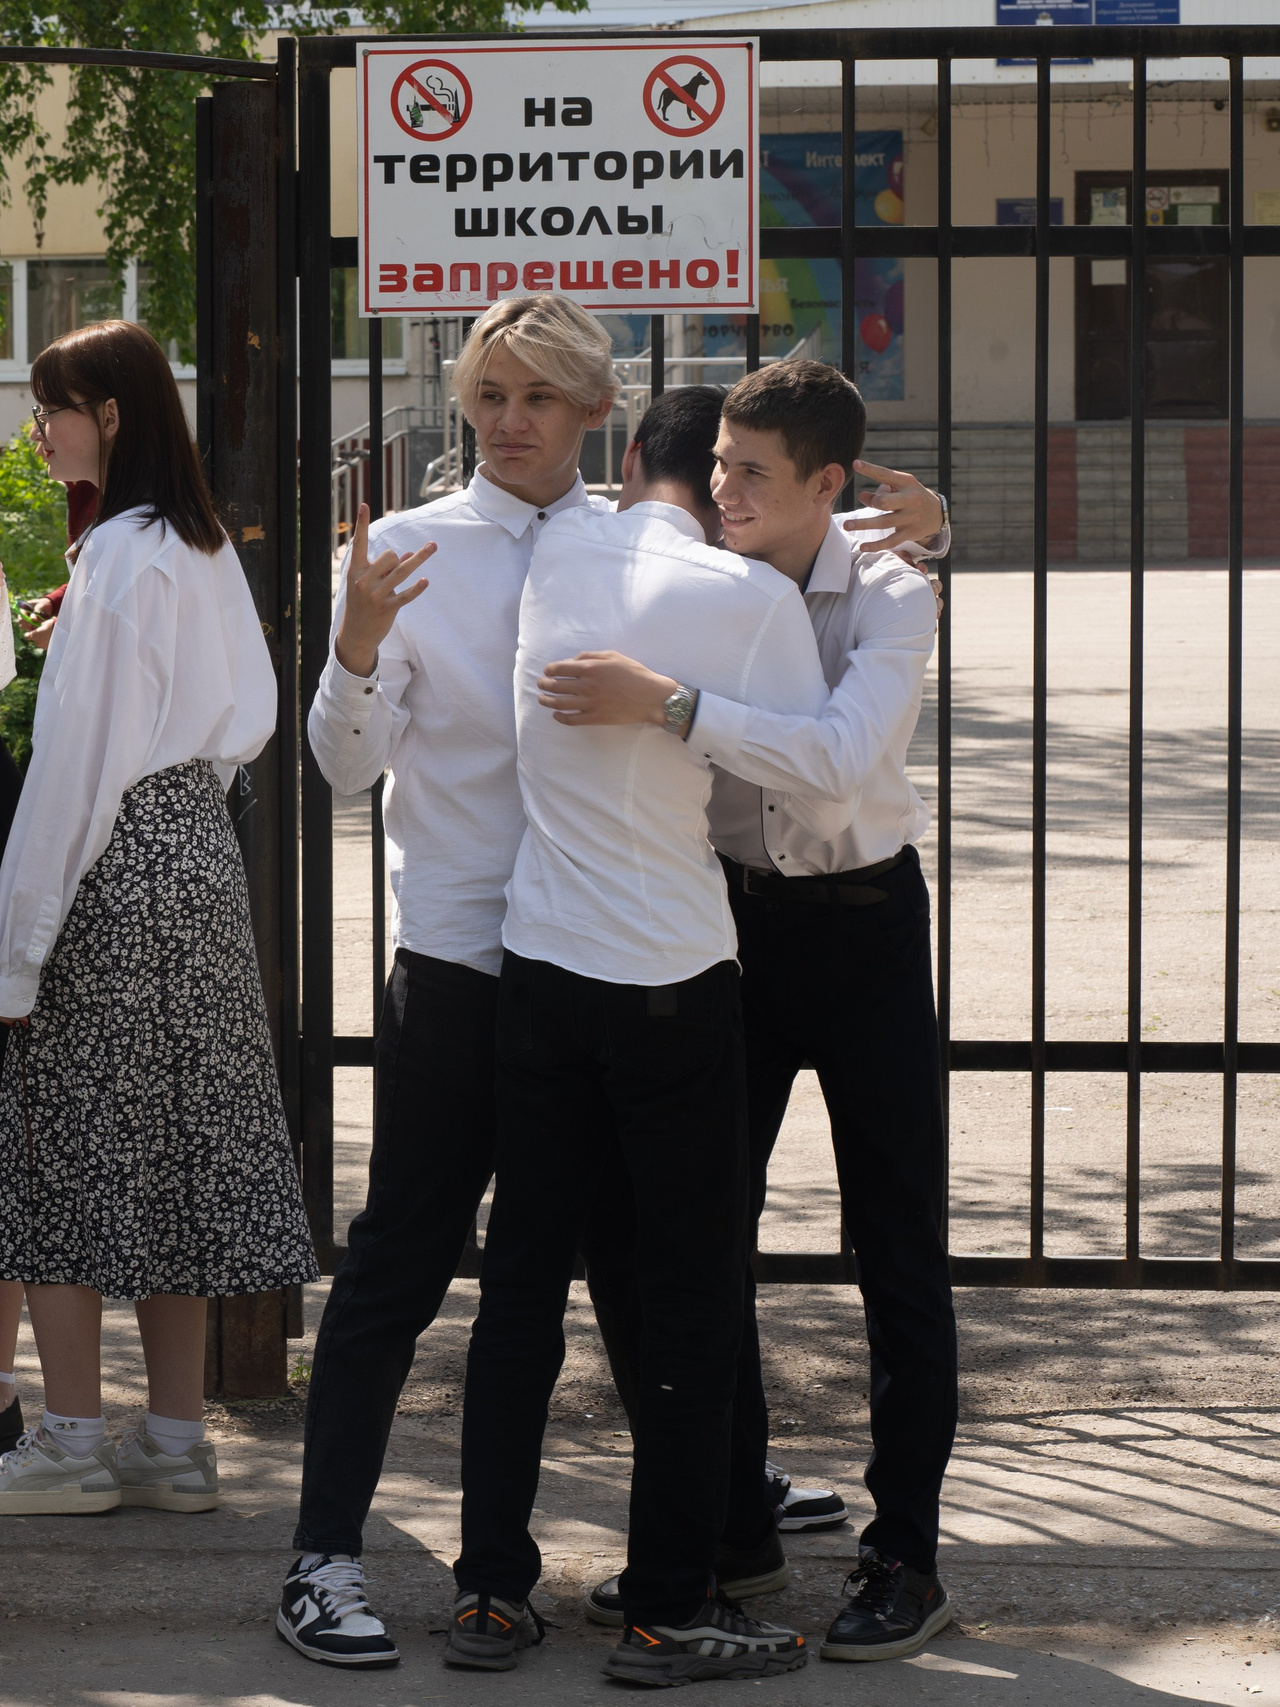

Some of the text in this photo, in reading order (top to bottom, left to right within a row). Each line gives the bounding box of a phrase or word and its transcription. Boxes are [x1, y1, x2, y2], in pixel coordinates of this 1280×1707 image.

[525, 97, 593, 127] на
[374, 148, 744, 192] территории
[454, 205, 663, 237] школы
[379, 249, 739, 300] запрещено!
